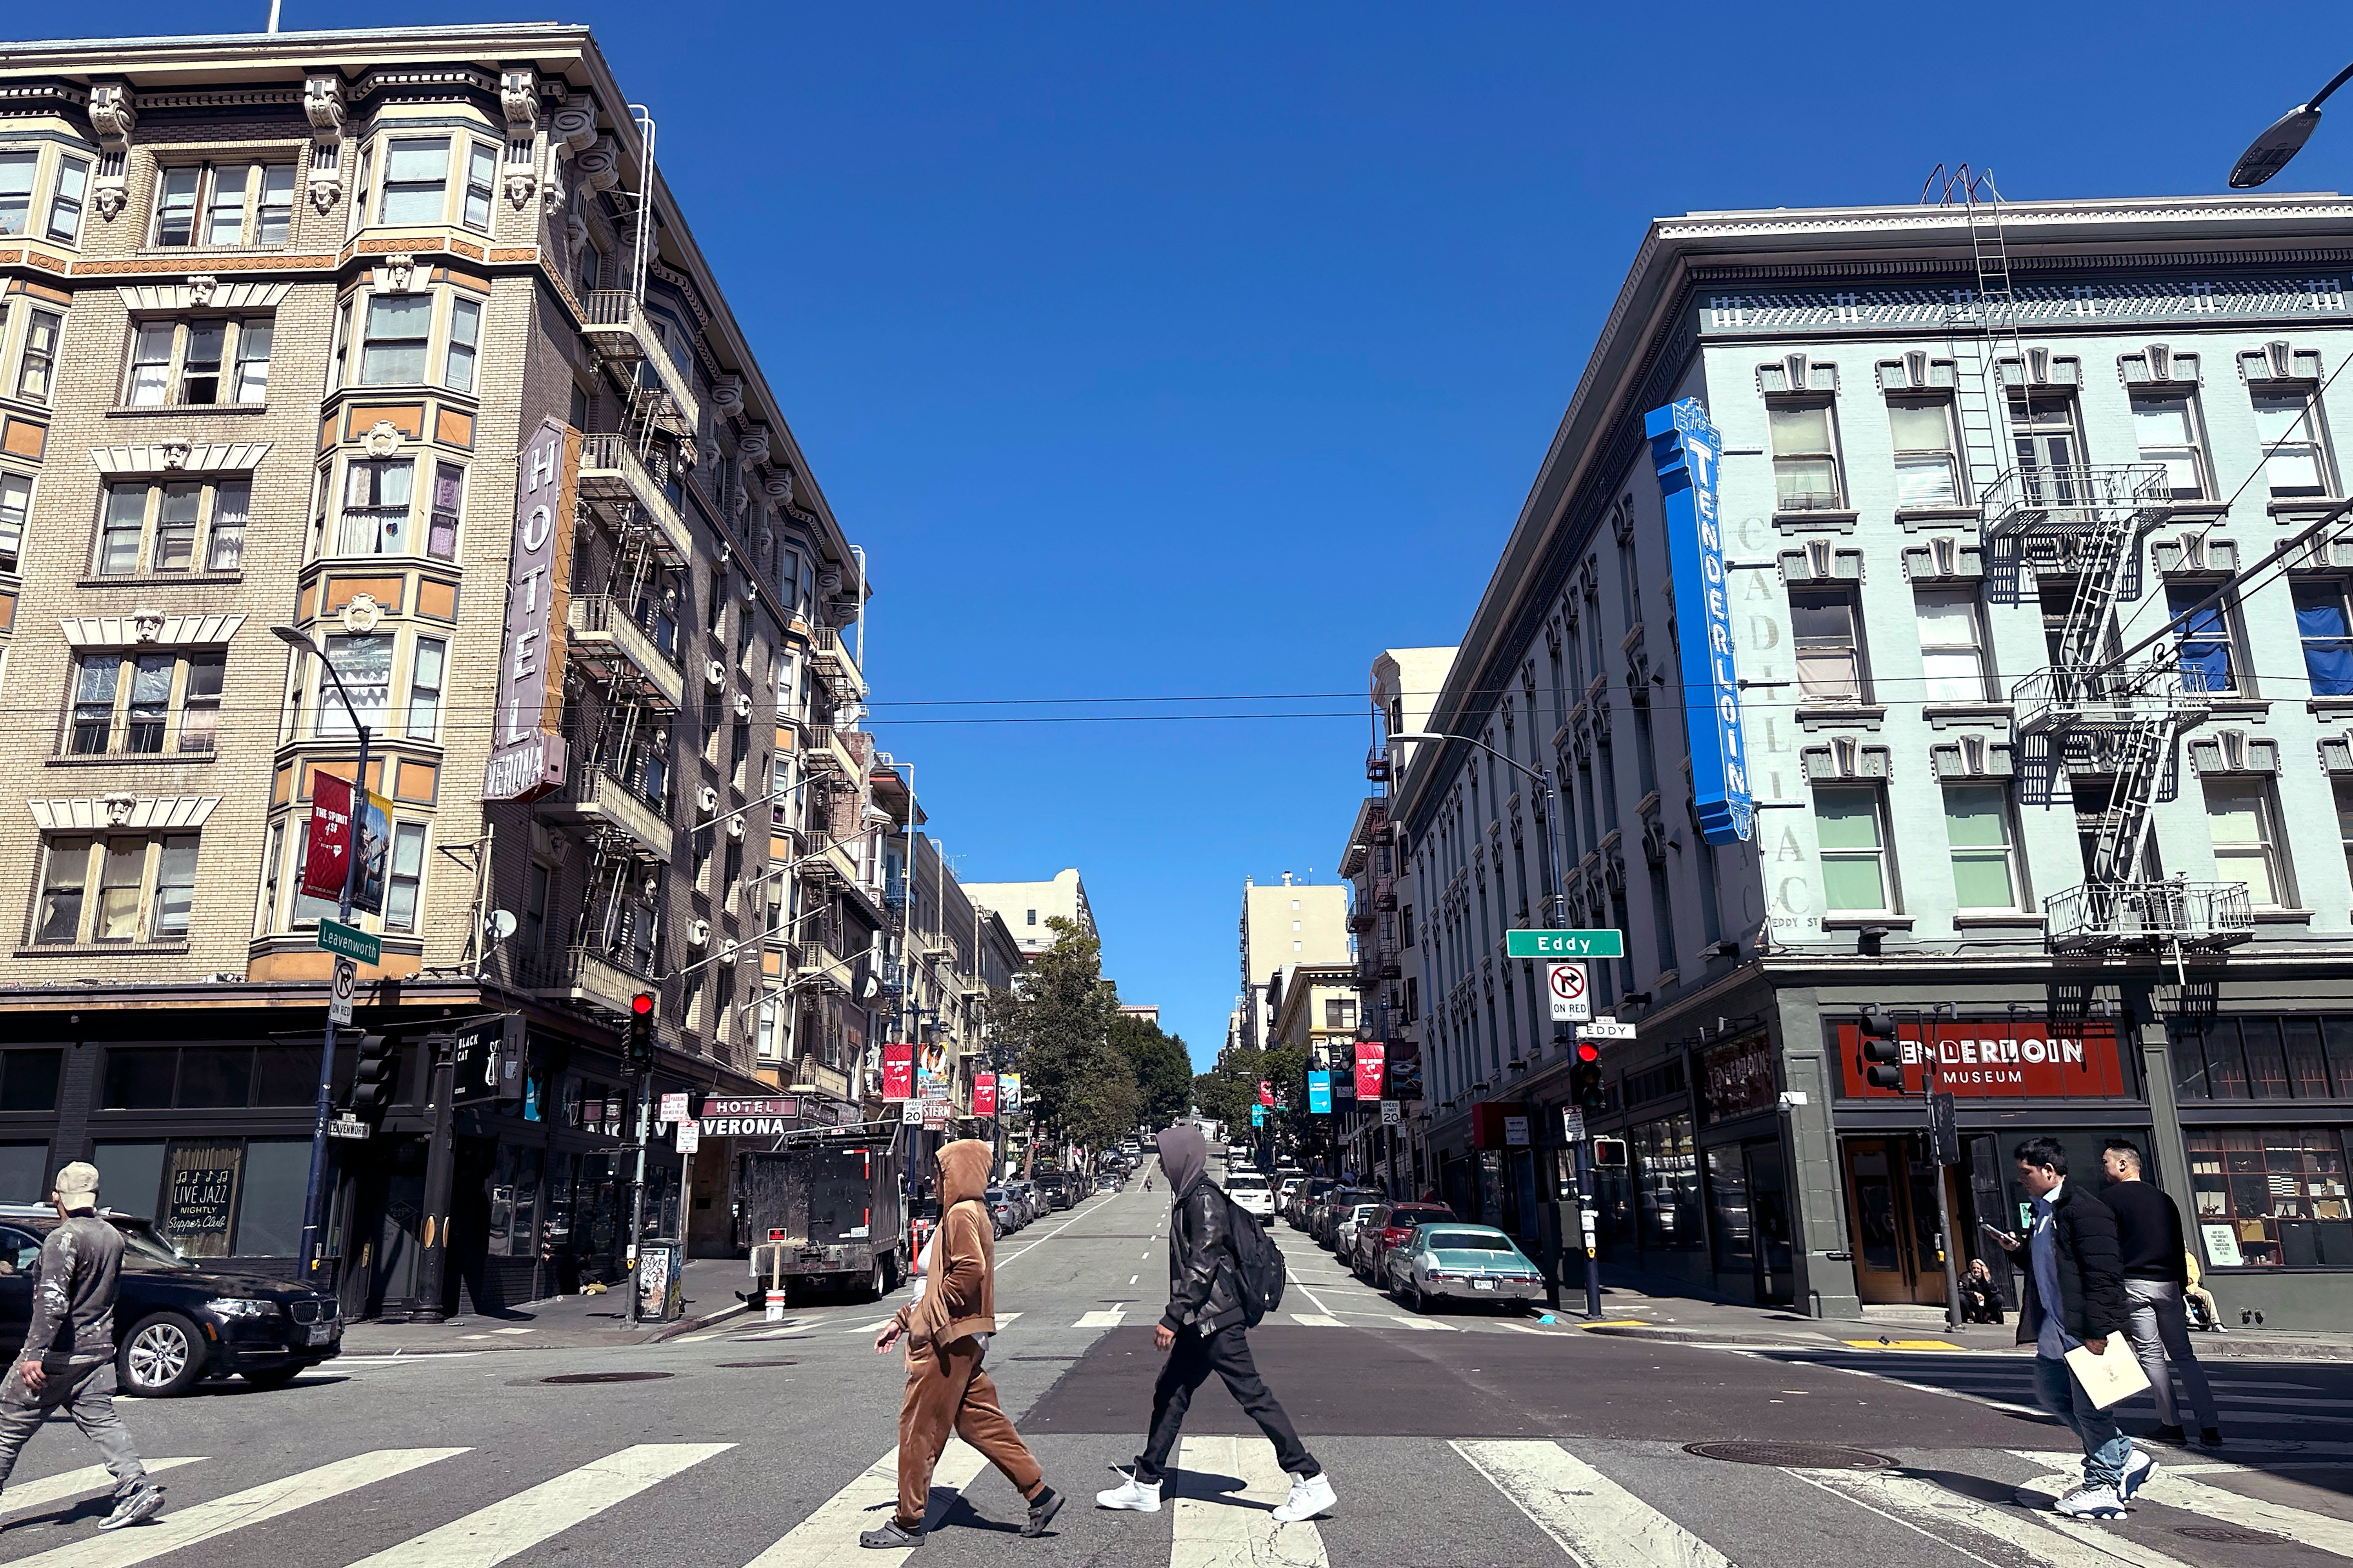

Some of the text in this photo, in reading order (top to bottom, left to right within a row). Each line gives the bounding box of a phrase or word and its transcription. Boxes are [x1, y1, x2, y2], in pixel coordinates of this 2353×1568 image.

[507, 440, 555, 743] HOTEL
[1687, 437, 1745, 794] TENDERLOIN
[487, 746, 543, 795] VERONA
[316, 806, 348, 825] THE SPIRIT
[330, 822, 338, 833] SF
[1771, 918, 1818, 927] EDDY ST
[323, 926, 376, 959] Leavenworth
[1538, 936, 1591, 954] Eddy
[332, 1003, 351, 1017] ON RED
[1554, 1004, 1586, 1013] ON RED
[1587, 1026, 1626, 1035] EDDY
[458, 1034, 479, 1049] BLACK
[458, 1050, 468, 1061] CAT
[1899, 1039, 2082, 1064] ENDERLOIN
[1943, 1071, 2022, 1083] MUSEUM
[716, 1101, 773, 1113] HOTEL
[923, 1106, 951, 1117] STERN
[906, 1112, 920, 1121] 20
[1384, 1113, 1399, 1122] 20
[703, 1118, 784, 1135] VERONA
[174, 1185, 227, 1204] LIVE JAZZ
[167, 1215, 226, 1232] Supper Club
